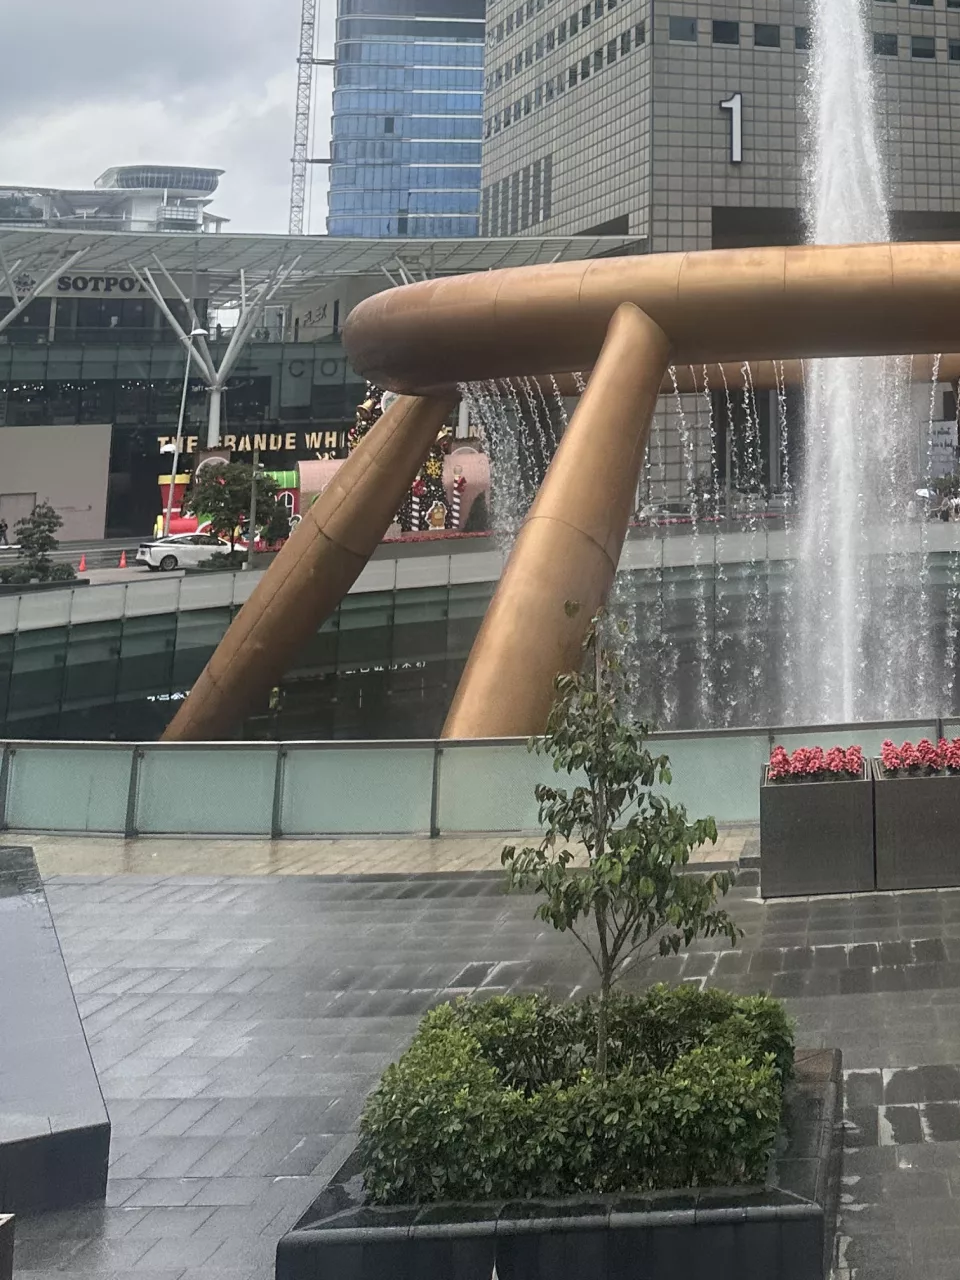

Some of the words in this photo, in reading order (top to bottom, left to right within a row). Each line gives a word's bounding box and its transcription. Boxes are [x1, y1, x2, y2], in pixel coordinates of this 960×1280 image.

[719, 92, 742, 163] 1
[218, 433, 297, 452] RANDE
[305, 430, 346, 449] WHI
